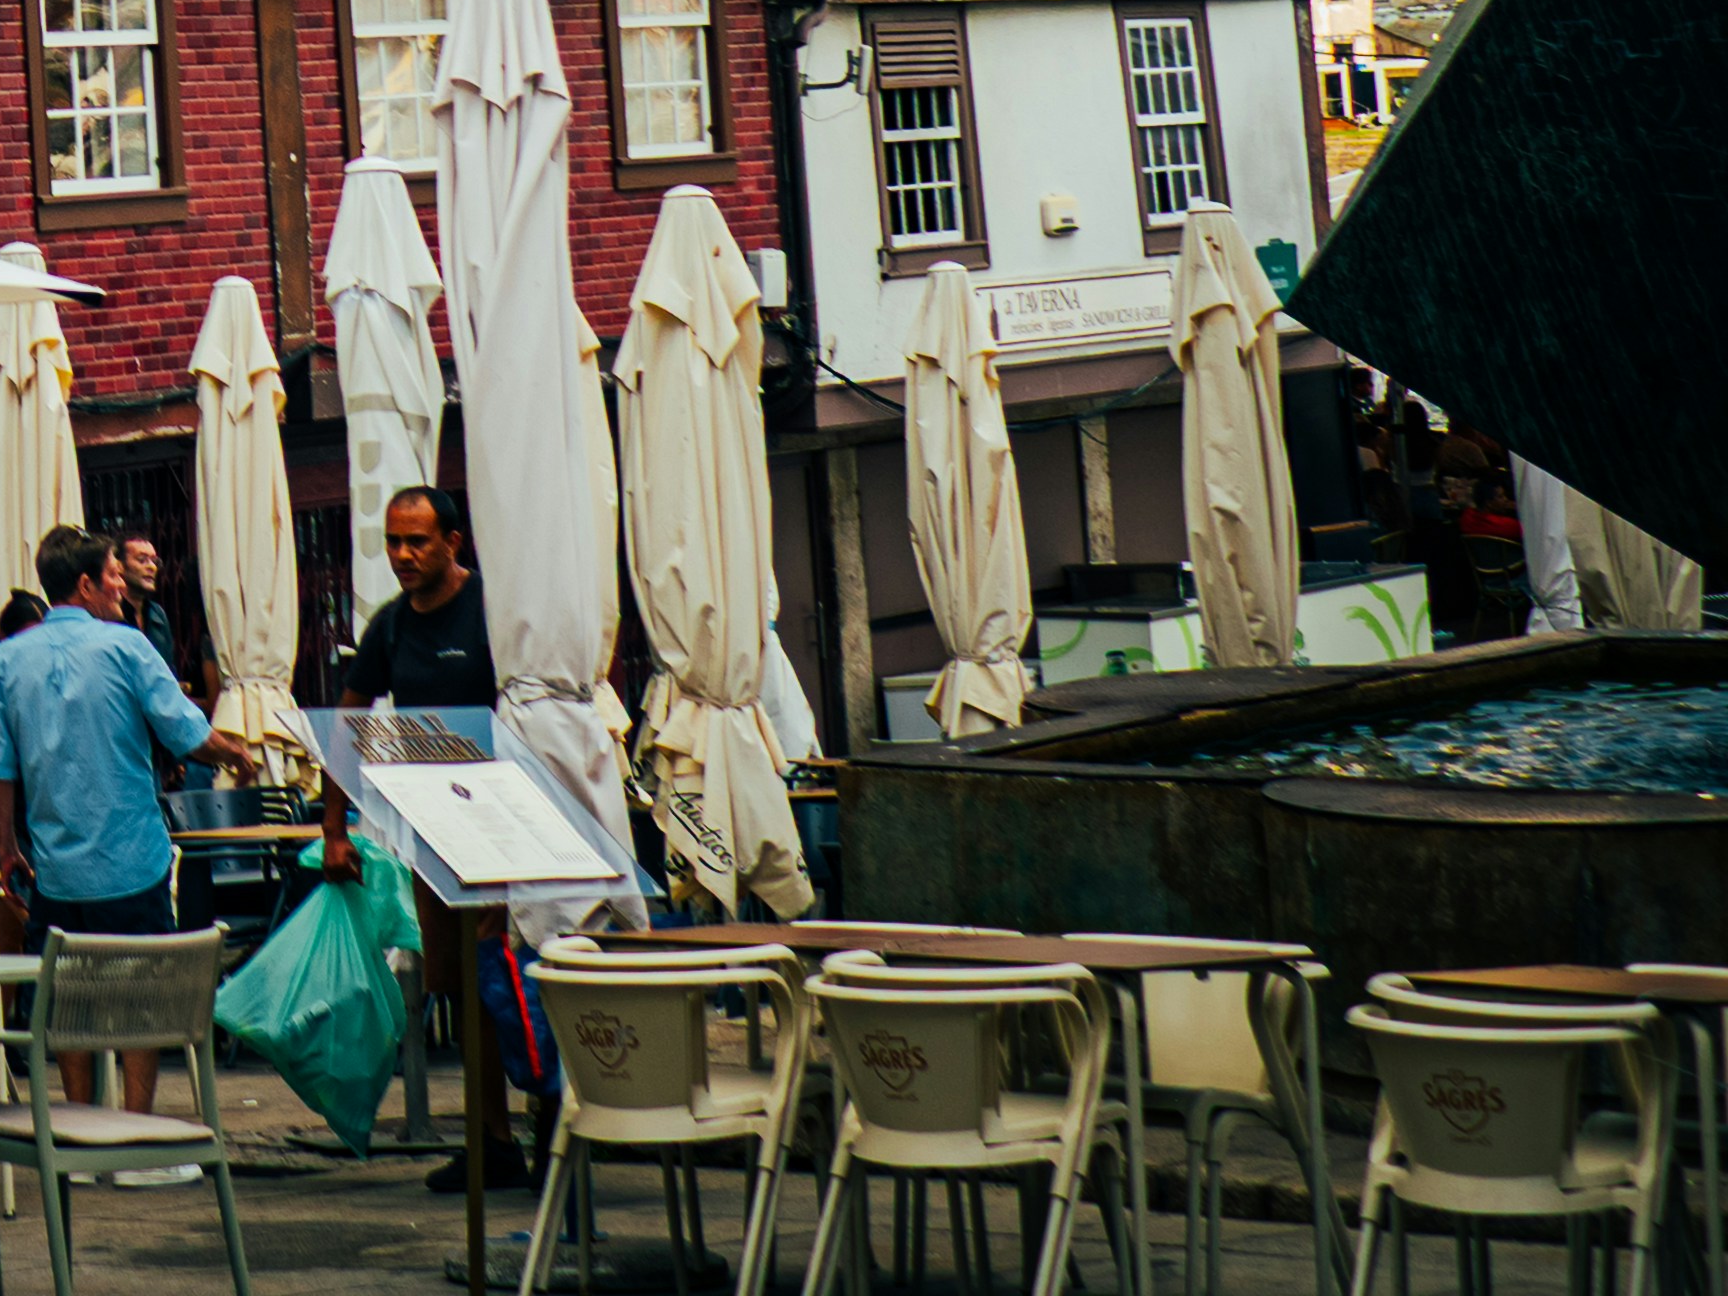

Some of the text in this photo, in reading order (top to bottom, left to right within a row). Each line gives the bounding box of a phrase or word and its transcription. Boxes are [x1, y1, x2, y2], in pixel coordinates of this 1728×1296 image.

[1016, 287, 1082, 315] TAVERNA
[858, 1042, 928, 1071] SAGRES
[1423, 1081, 1507, 1114] SAGRES
